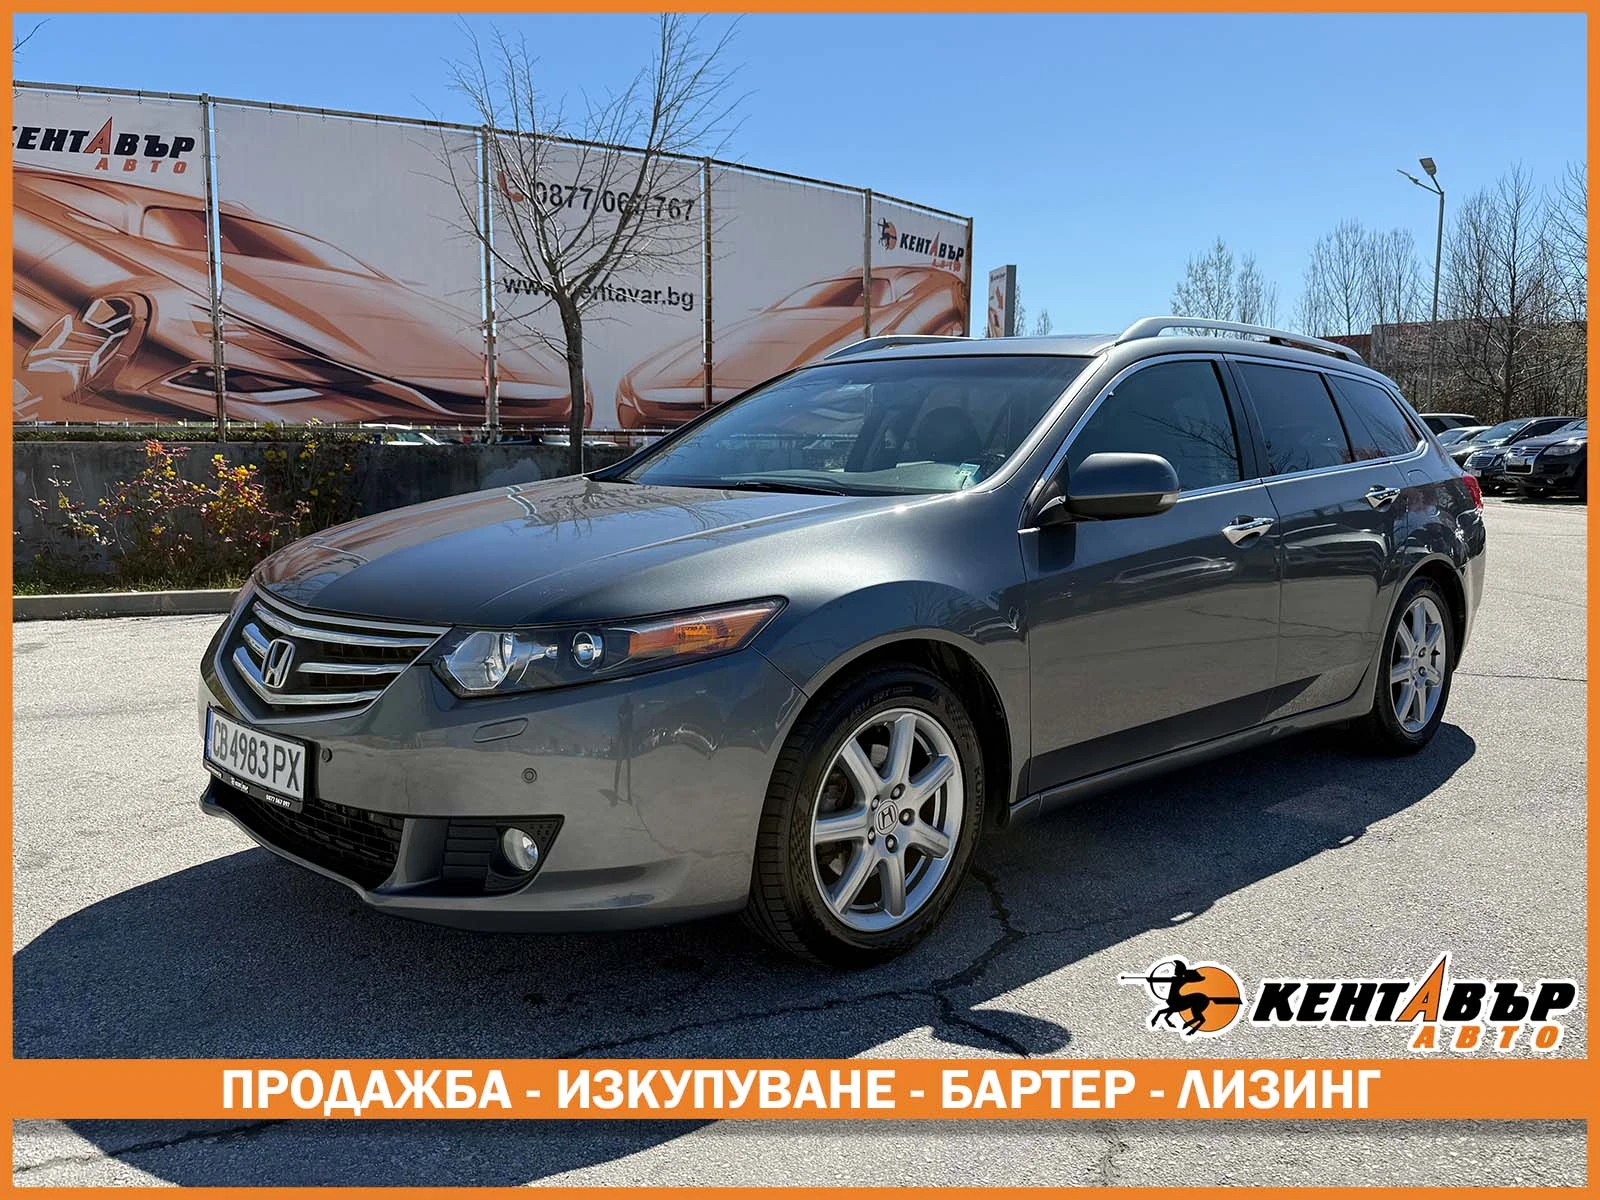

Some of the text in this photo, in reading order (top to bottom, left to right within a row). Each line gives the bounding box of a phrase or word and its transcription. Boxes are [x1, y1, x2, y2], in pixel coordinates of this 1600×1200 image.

[13, 116, 195, 158] ЕНТАВЪР
[95, 157, 187, 173] АВТО
[536, 182, 695, 220] 0877 06 767
[900, 232, 964, 262] КЕНТАВЪР
